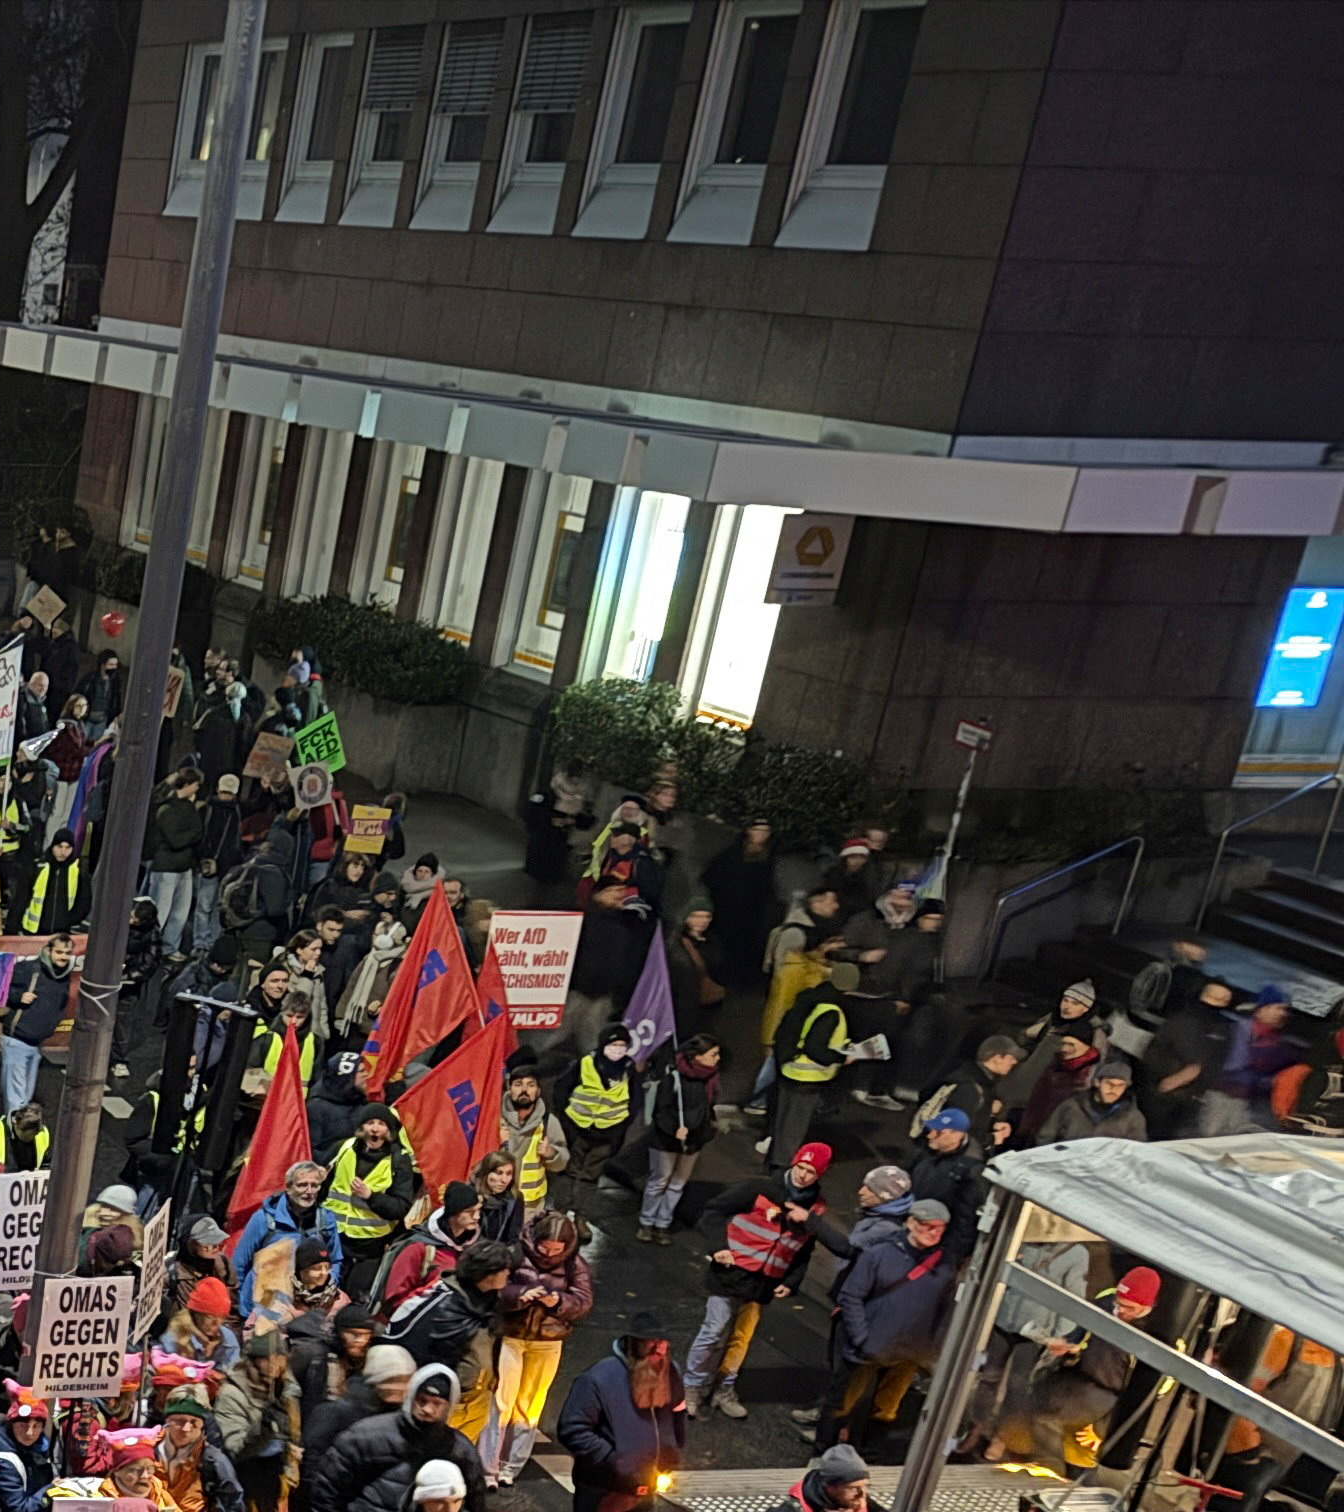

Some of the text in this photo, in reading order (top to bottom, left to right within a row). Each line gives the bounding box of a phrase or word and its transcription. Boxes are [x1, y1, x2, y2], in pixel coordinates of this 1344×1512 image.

[299, 723, 336, 755] FCK
[306, 737, 340, 765] AFD
[494, 927, 547, 945] Wer AfD
[532, 950, 569, 968] wählt
[499, 972, 564, 990] SCHISMUS!
[514, 1012, 559, 1026] MLPD
[9, 1180, 50, 1207] OMA
[2, 1212, 42, 1240] GEG
[59, 1284, 118, 1314] OMAS
[49, 1317, 120, 1347] GEGEN
[38, 1350, 120, 1380] RECHTS
[44, 1382, 109, 1393] HILDESHEIM
